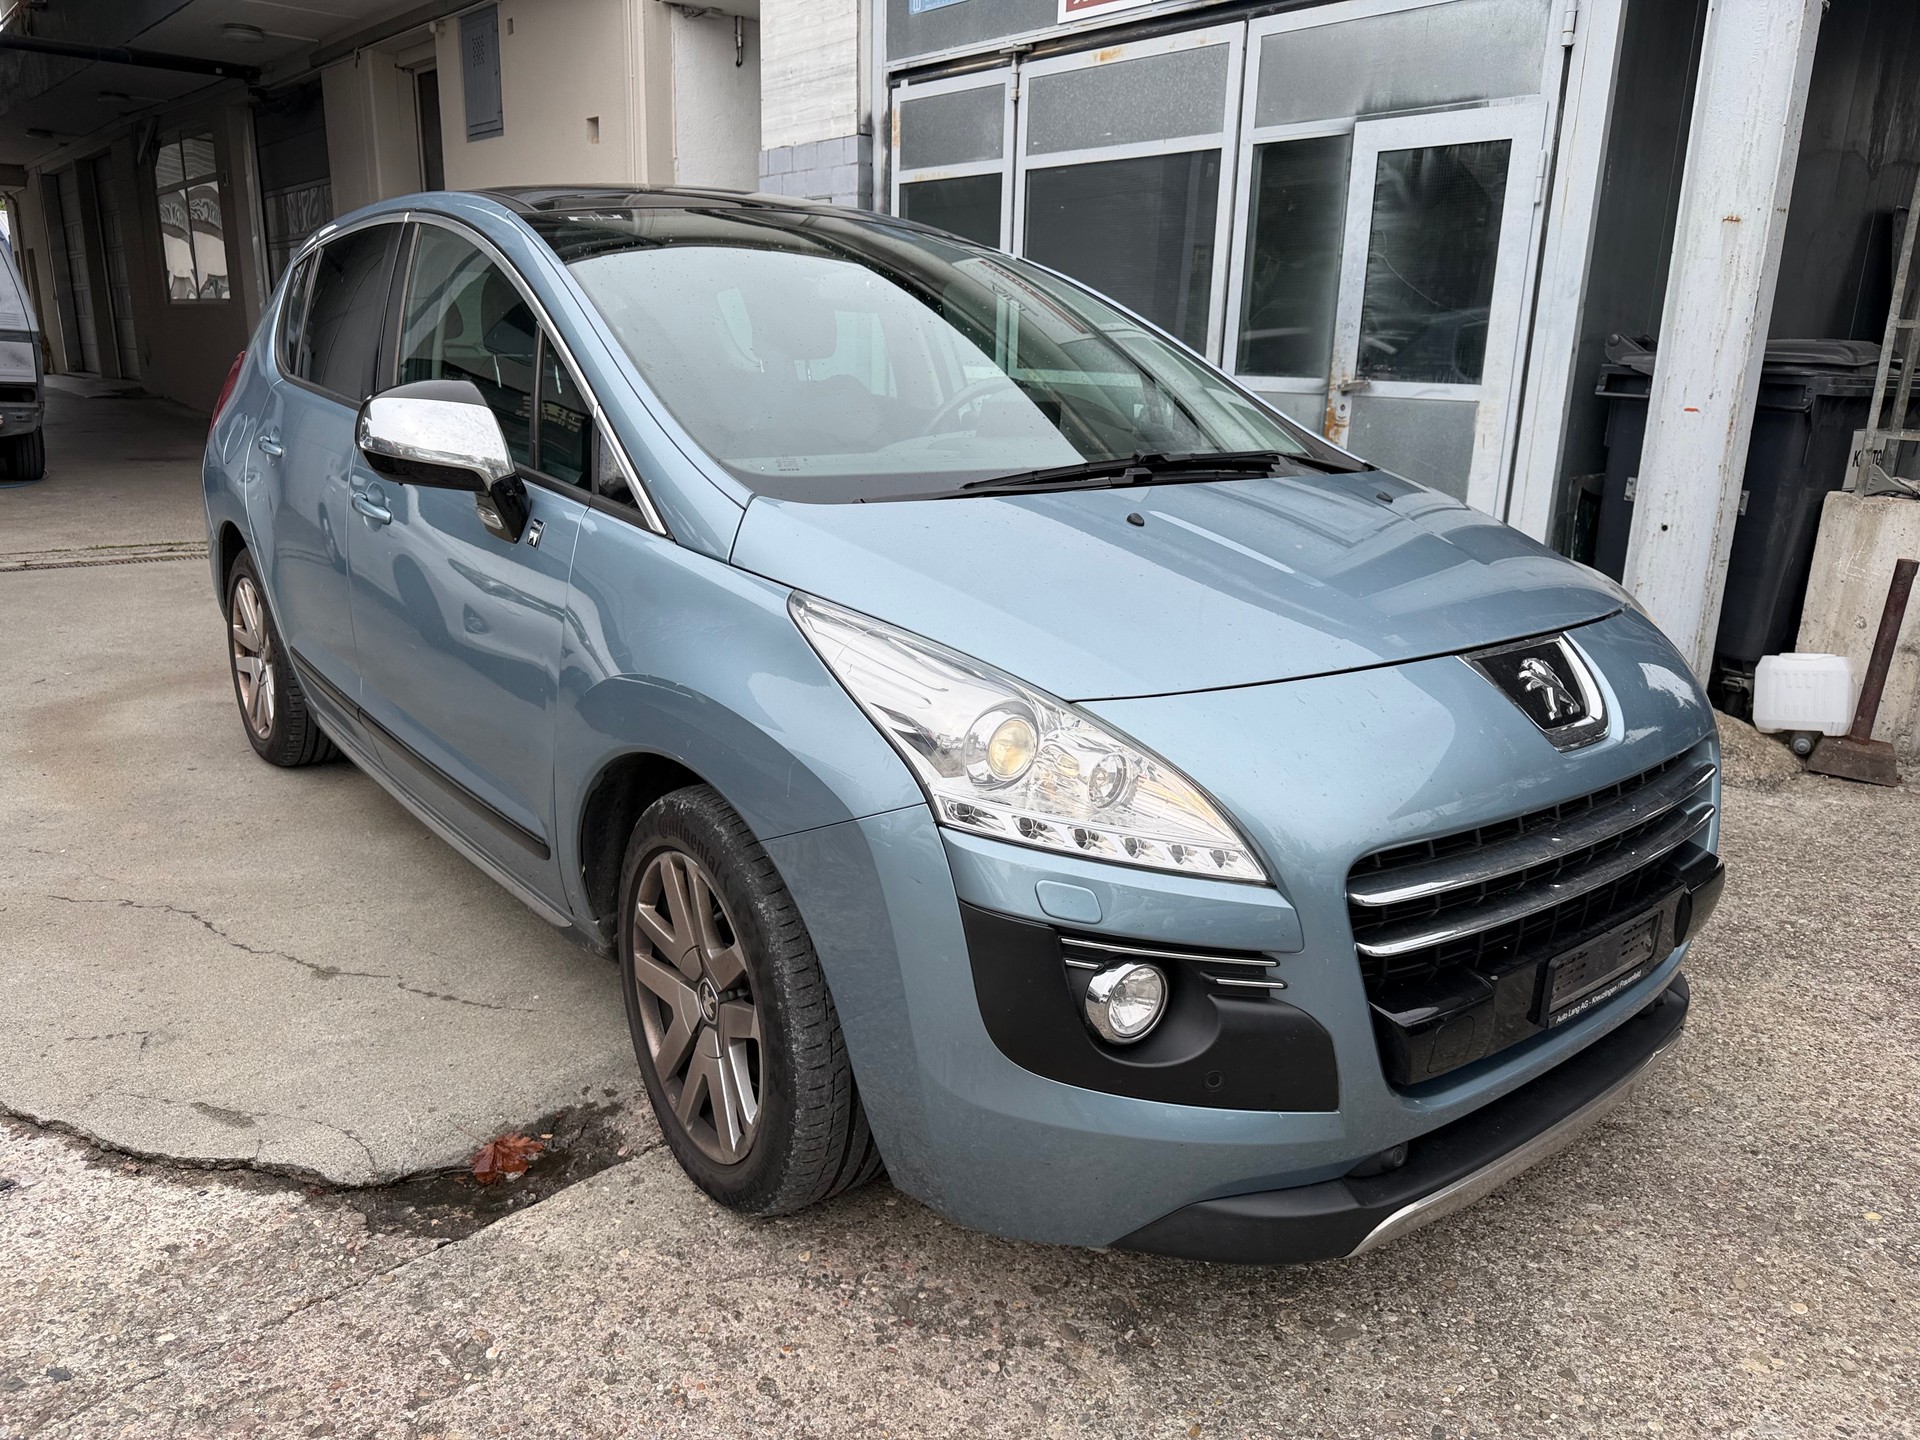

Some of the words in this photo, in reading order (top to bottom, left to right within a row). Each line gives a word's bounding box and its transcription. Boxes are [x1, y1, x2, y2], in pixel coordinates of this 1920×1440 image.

[658, 815, 723, 880] Continental
[1556, 1012, 1568, 1024] Auto
[1568, 1005, 1581, 1018] Lang
[1580, 1000, 1589, 1011] AG
